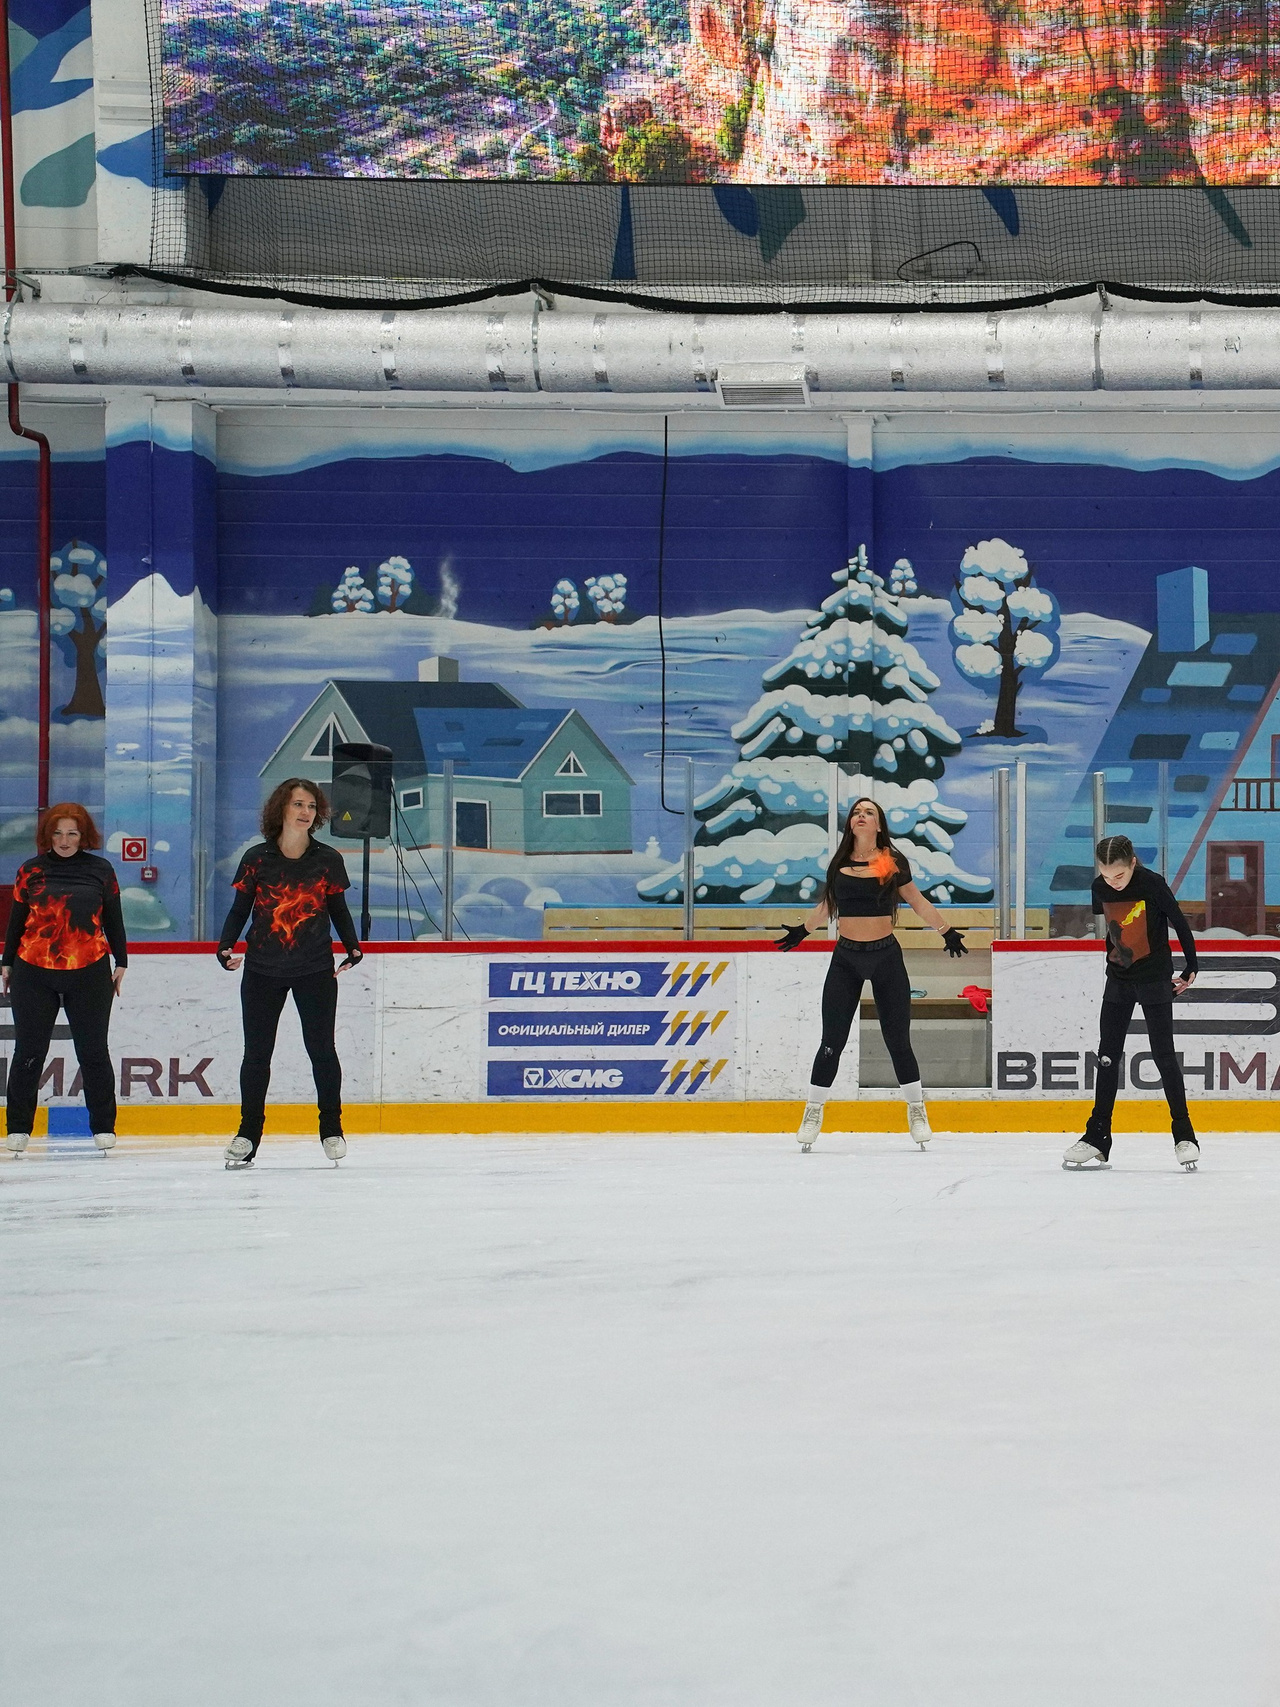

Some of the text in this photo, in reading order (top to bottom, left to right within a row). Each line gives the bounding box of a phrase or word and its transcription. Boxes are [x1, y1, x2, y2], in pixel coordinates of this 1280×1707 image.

[510, 970, 642, 994] ГЦ ТЕХНО
[498, 1022, 651, 1037] ОФИЦИАЛЬНЫЙ ДИЛЕР
[544, 1068, 624, 1089] XCMG
